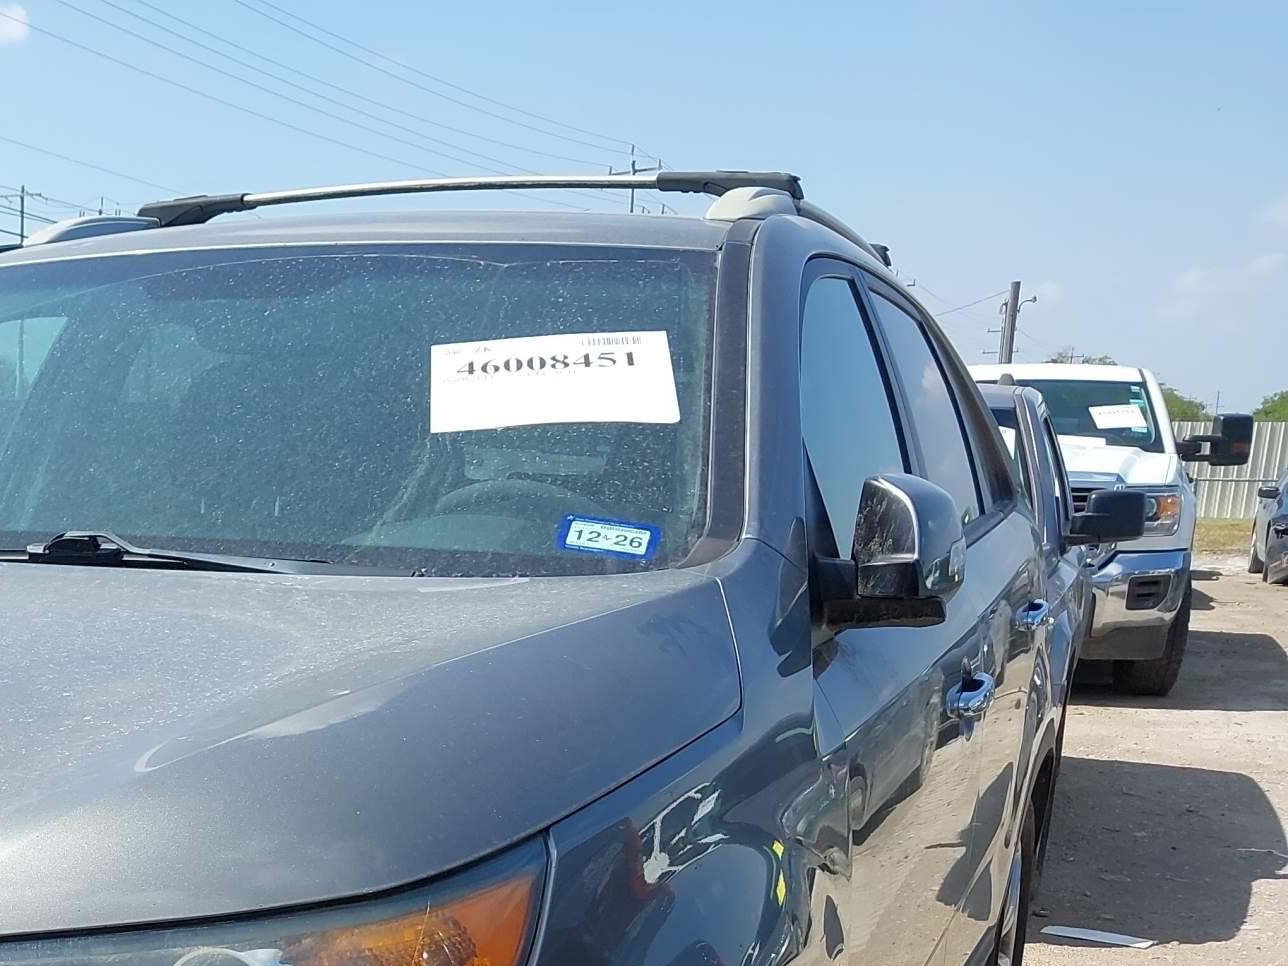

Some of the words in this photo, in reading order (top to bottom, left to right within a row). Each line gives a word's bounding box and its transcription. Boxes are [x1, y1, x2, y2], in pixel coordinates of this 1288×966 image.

[456, 351, 636, 375] 46008451
[574, 529, 602, 543] 12
[613, 534, 644, 549] 26
